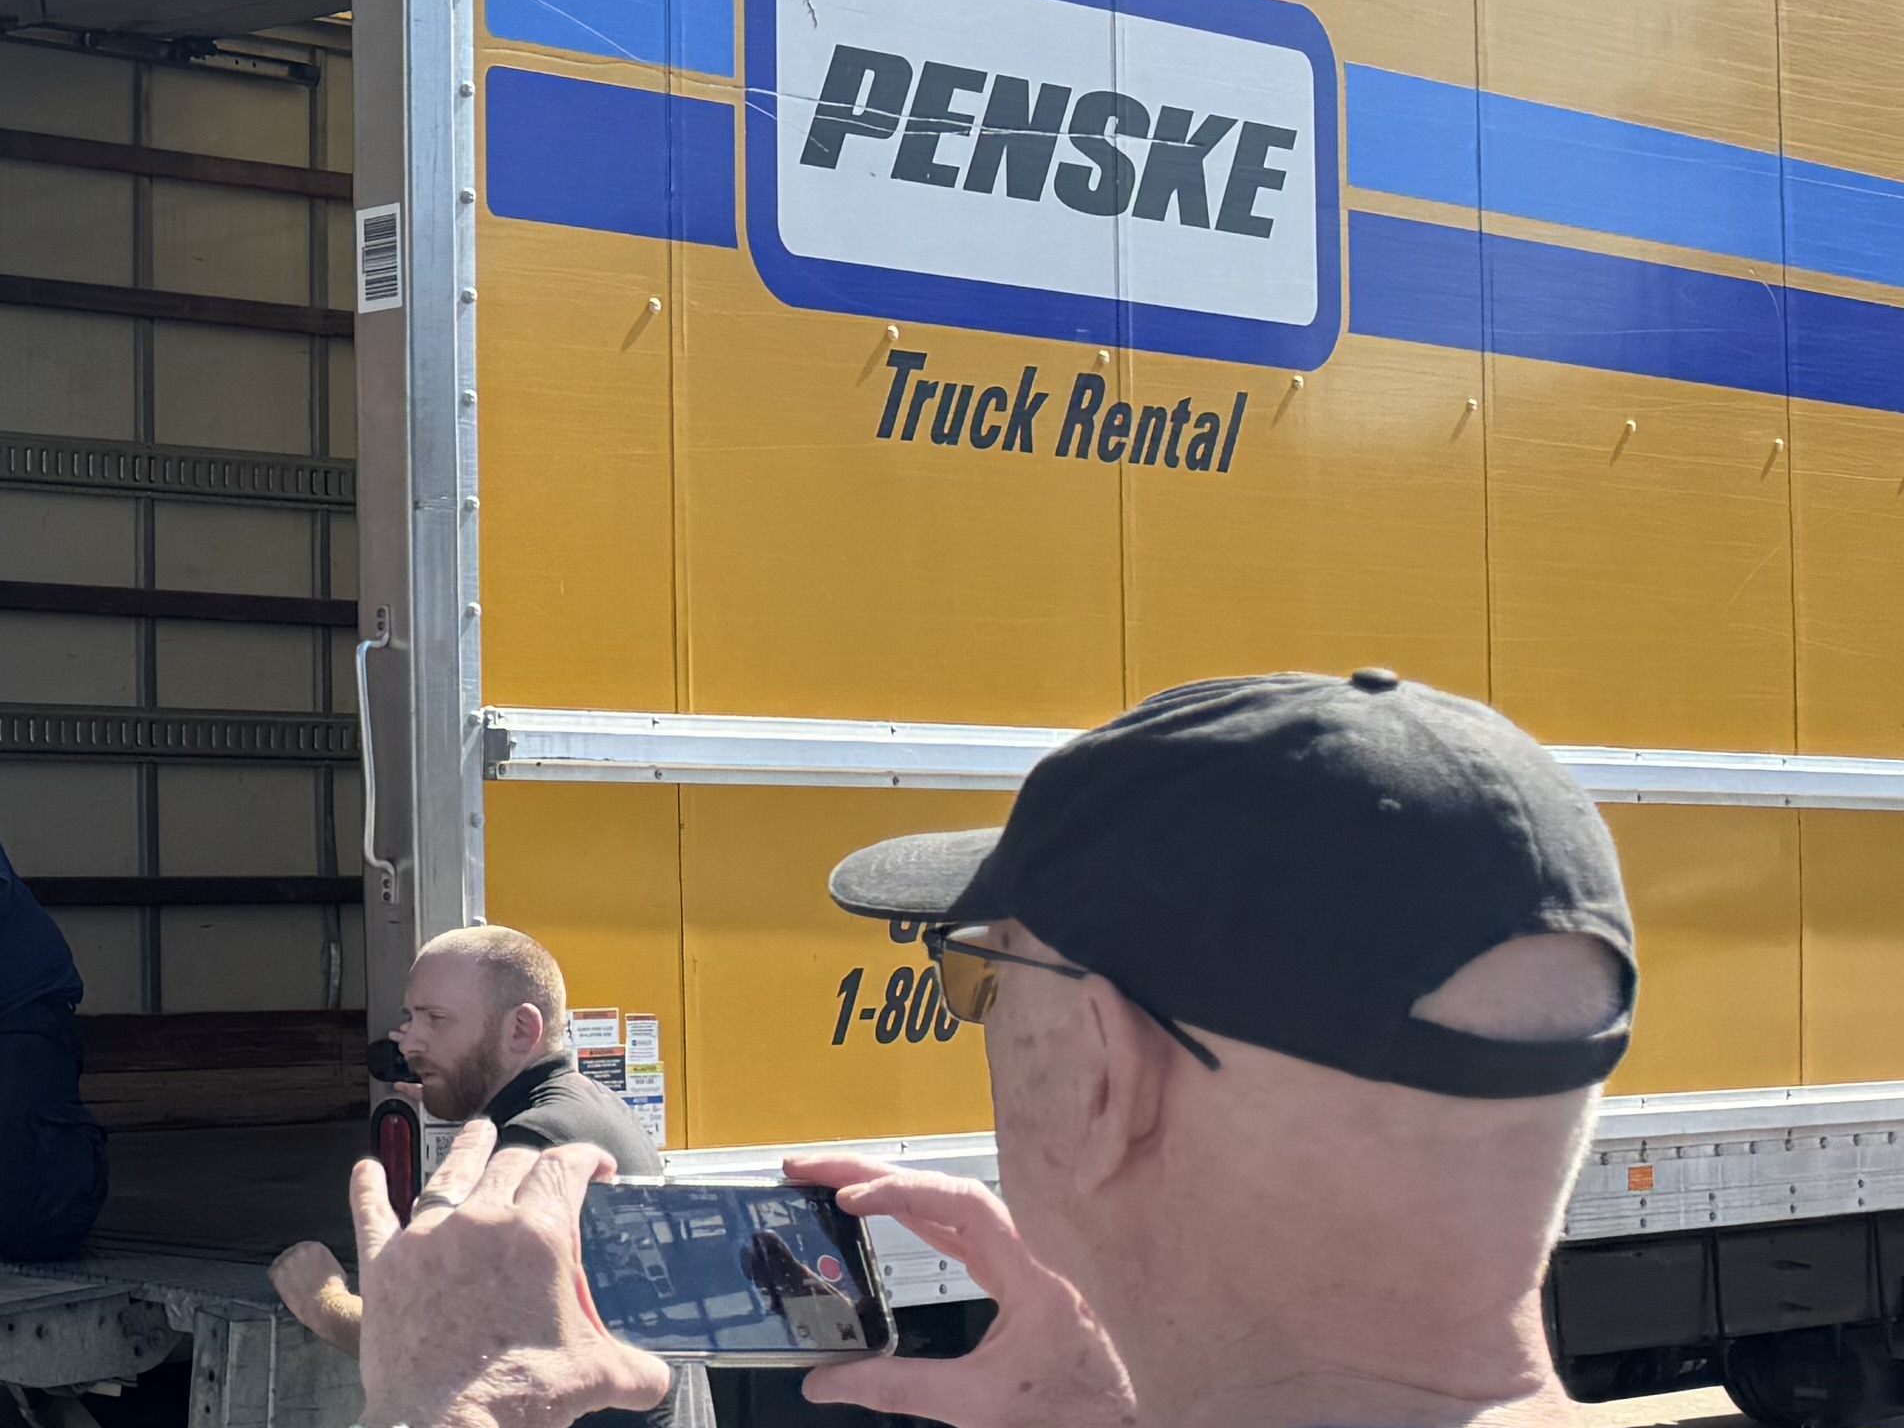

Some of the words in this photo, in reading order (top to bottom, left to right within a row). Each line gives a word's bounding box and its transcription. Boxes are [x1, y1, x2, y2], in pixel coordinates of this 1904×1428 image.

[800, 45, 1297, 238] PENSKE
[877, 349, 1049, 454] Truck
[1055, 373, 1247, 472] Rental
